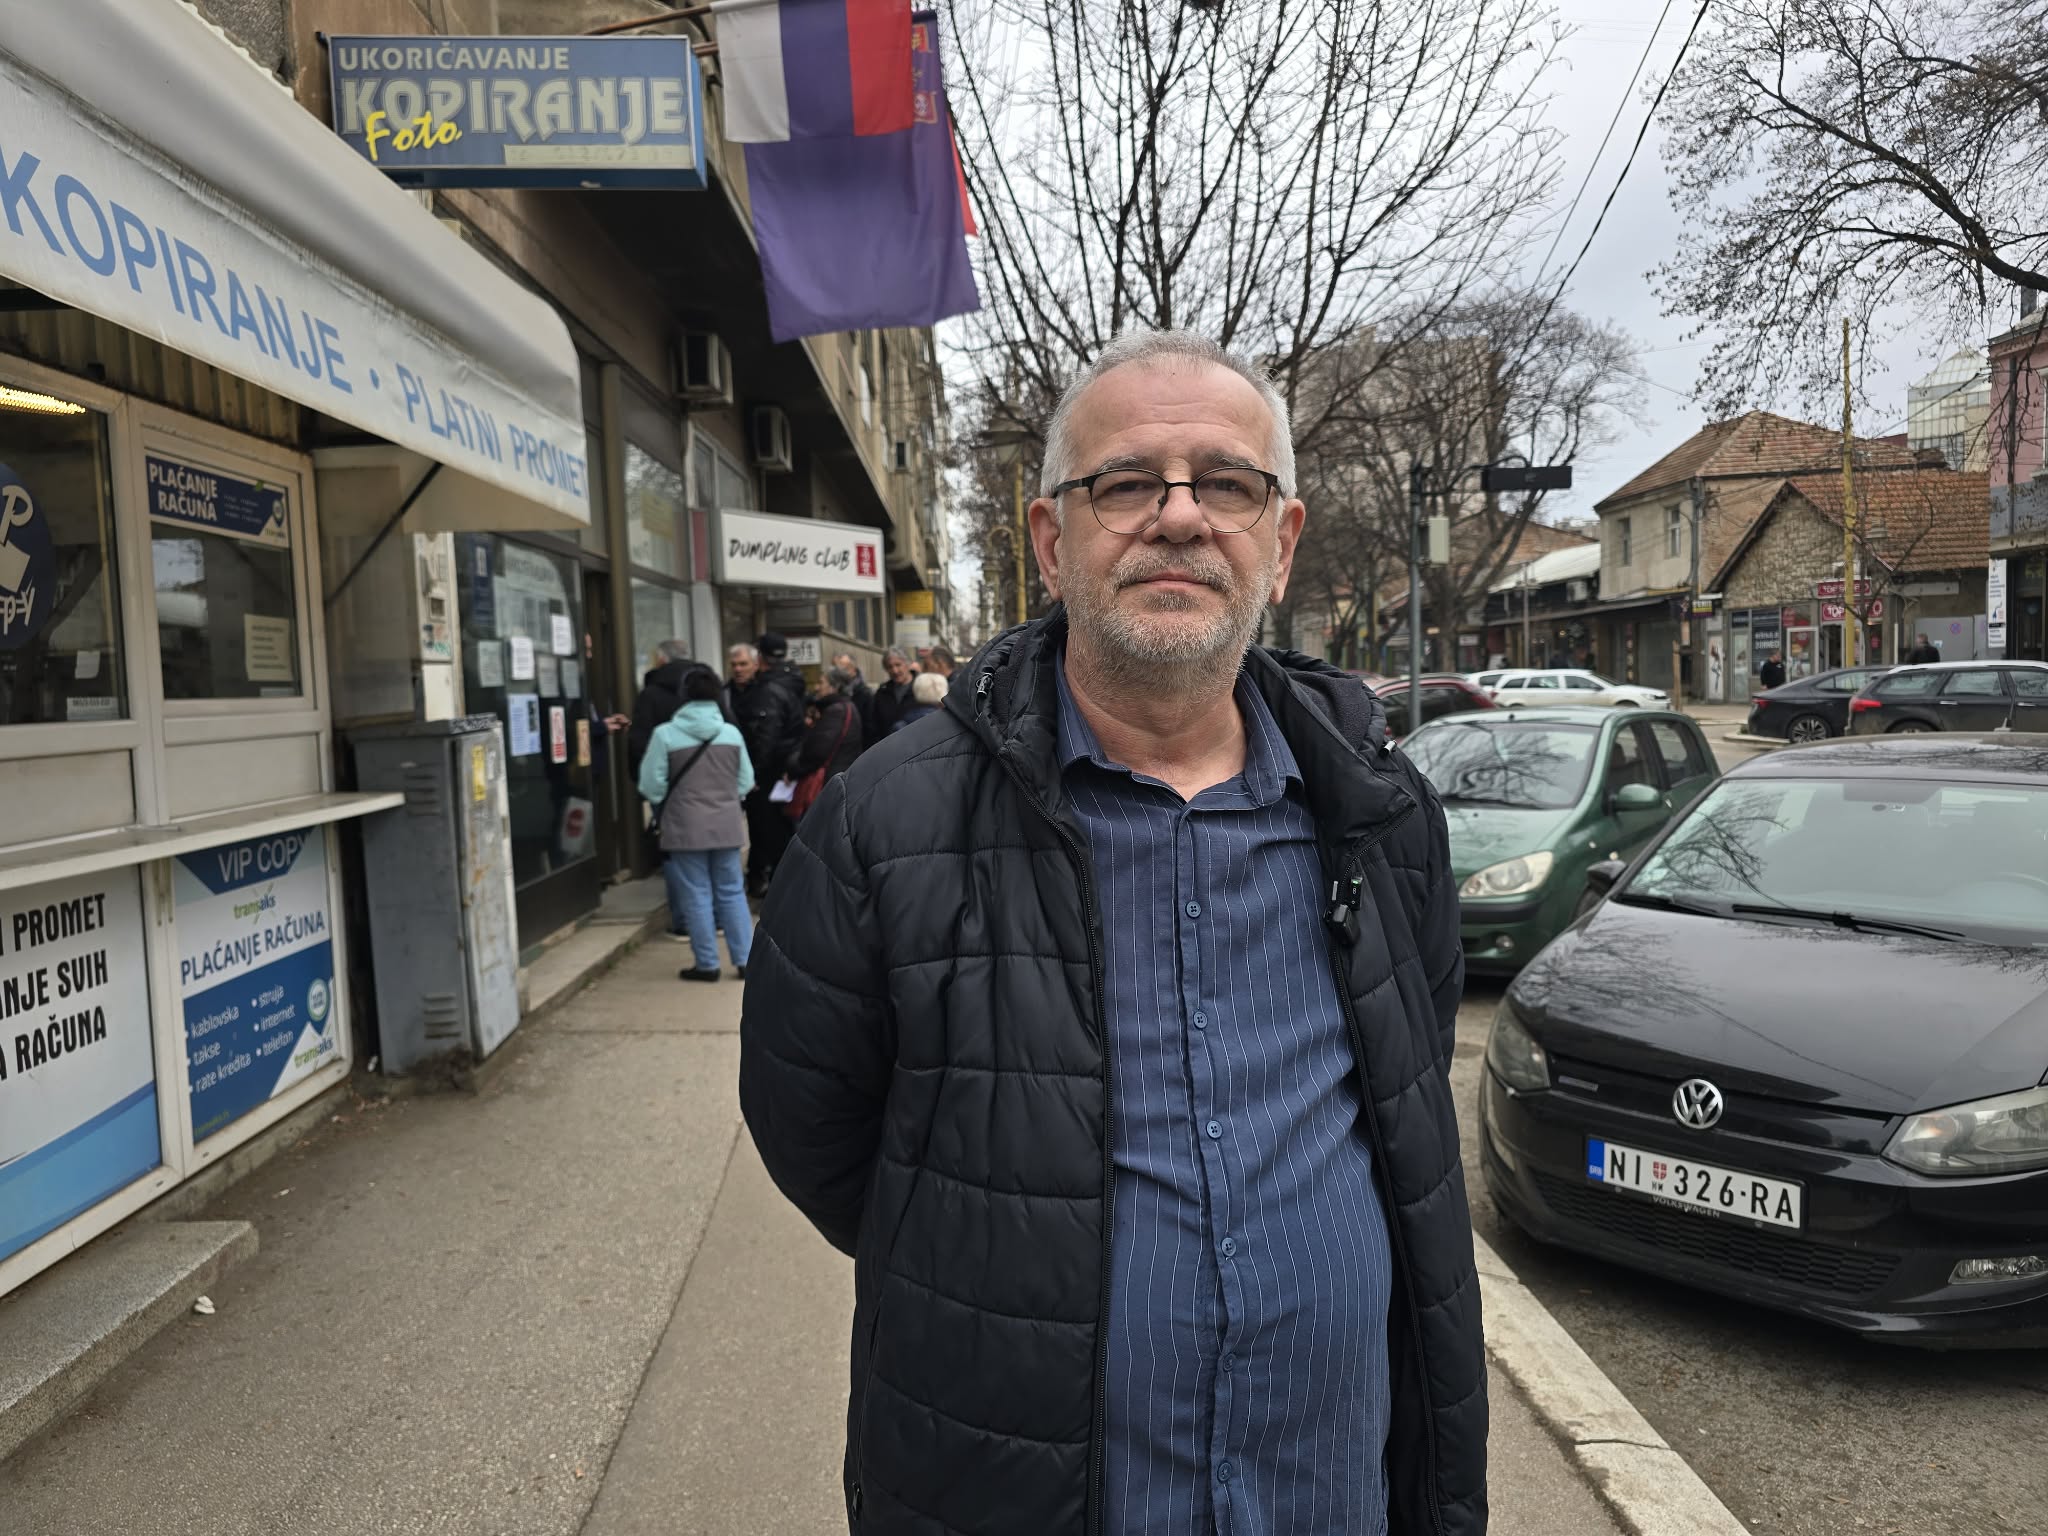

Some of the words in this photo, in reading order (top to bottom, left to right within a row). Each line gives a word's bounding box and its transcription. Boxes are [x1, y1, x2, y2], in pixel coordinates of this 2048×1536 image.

[339, 41, 569, 71] UKORIČAVANJE
[341, 78, 686, 145] KOPIRANJE
[366, 111, 462, 161] Foto
[0, 143, 352, 394] KOPIRANJE
[396, 362, 502, 463] PLATNI
[508, 423, 589, 498] PROMET
[149, 463, 218, 500] PLAĆANJE
[157, 488, 217, 521] RAČUNA
[729, 538, 808, 566] DUMPLING
[218, 847, 252, 883] VIP
[13, 893, 105, 951] PROMET
[180, 931, 262, 985] PLAĆANJE
[264, 910, 326, 952] RAČUNA
[0, 968, 50, 1021] NJE
[57, 949, 108, 998] SVIH
[15, 1005, 107, 1074] RAČUNA
[192, 1041, 221, 1067] takse
[1652, 1194, 1721, 1219] VOLKSWAGEN
